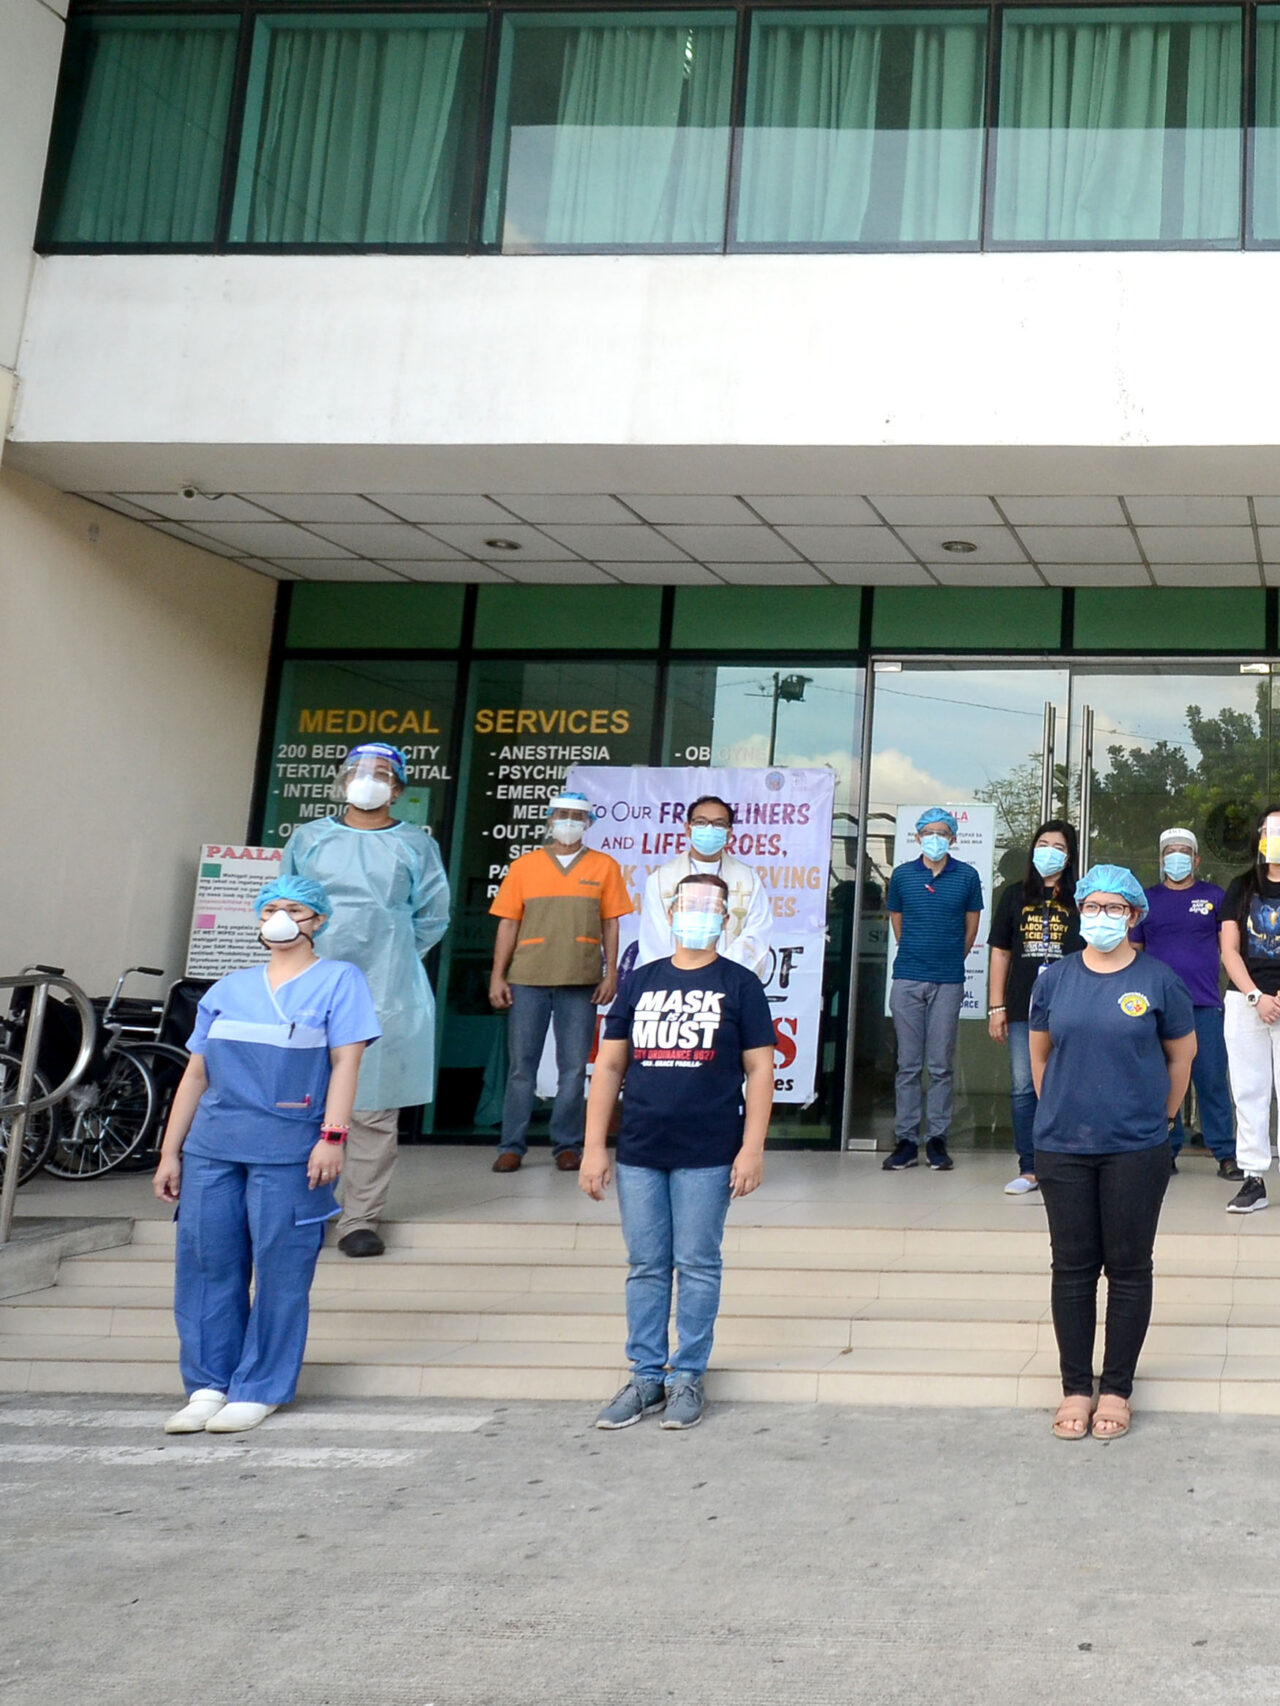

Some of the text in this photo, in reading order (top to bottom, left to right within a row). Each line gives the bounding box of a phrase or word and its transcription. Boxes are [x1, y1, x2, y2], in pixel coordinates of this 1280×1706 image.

[298, 709, 631, 734] MEDICAL SERVICES
[277, 744, 307, 758] 200
[311, 744, 348, 759] BED
[498, 746, 611, 760] ANESTHESIA
[403, 765, 452, 780] PITAL
[658, 801, 811, 826] FRLINERS
[206, 845, 284, 861] PAALA
[601, 836, 634, 851] AND
[641, 832, 687, 855] LIFE
[756, 865, 821, 889] RVING
[634, 989, 726, 1014] MASK
[631, 1019, 720, 1049] MUST
